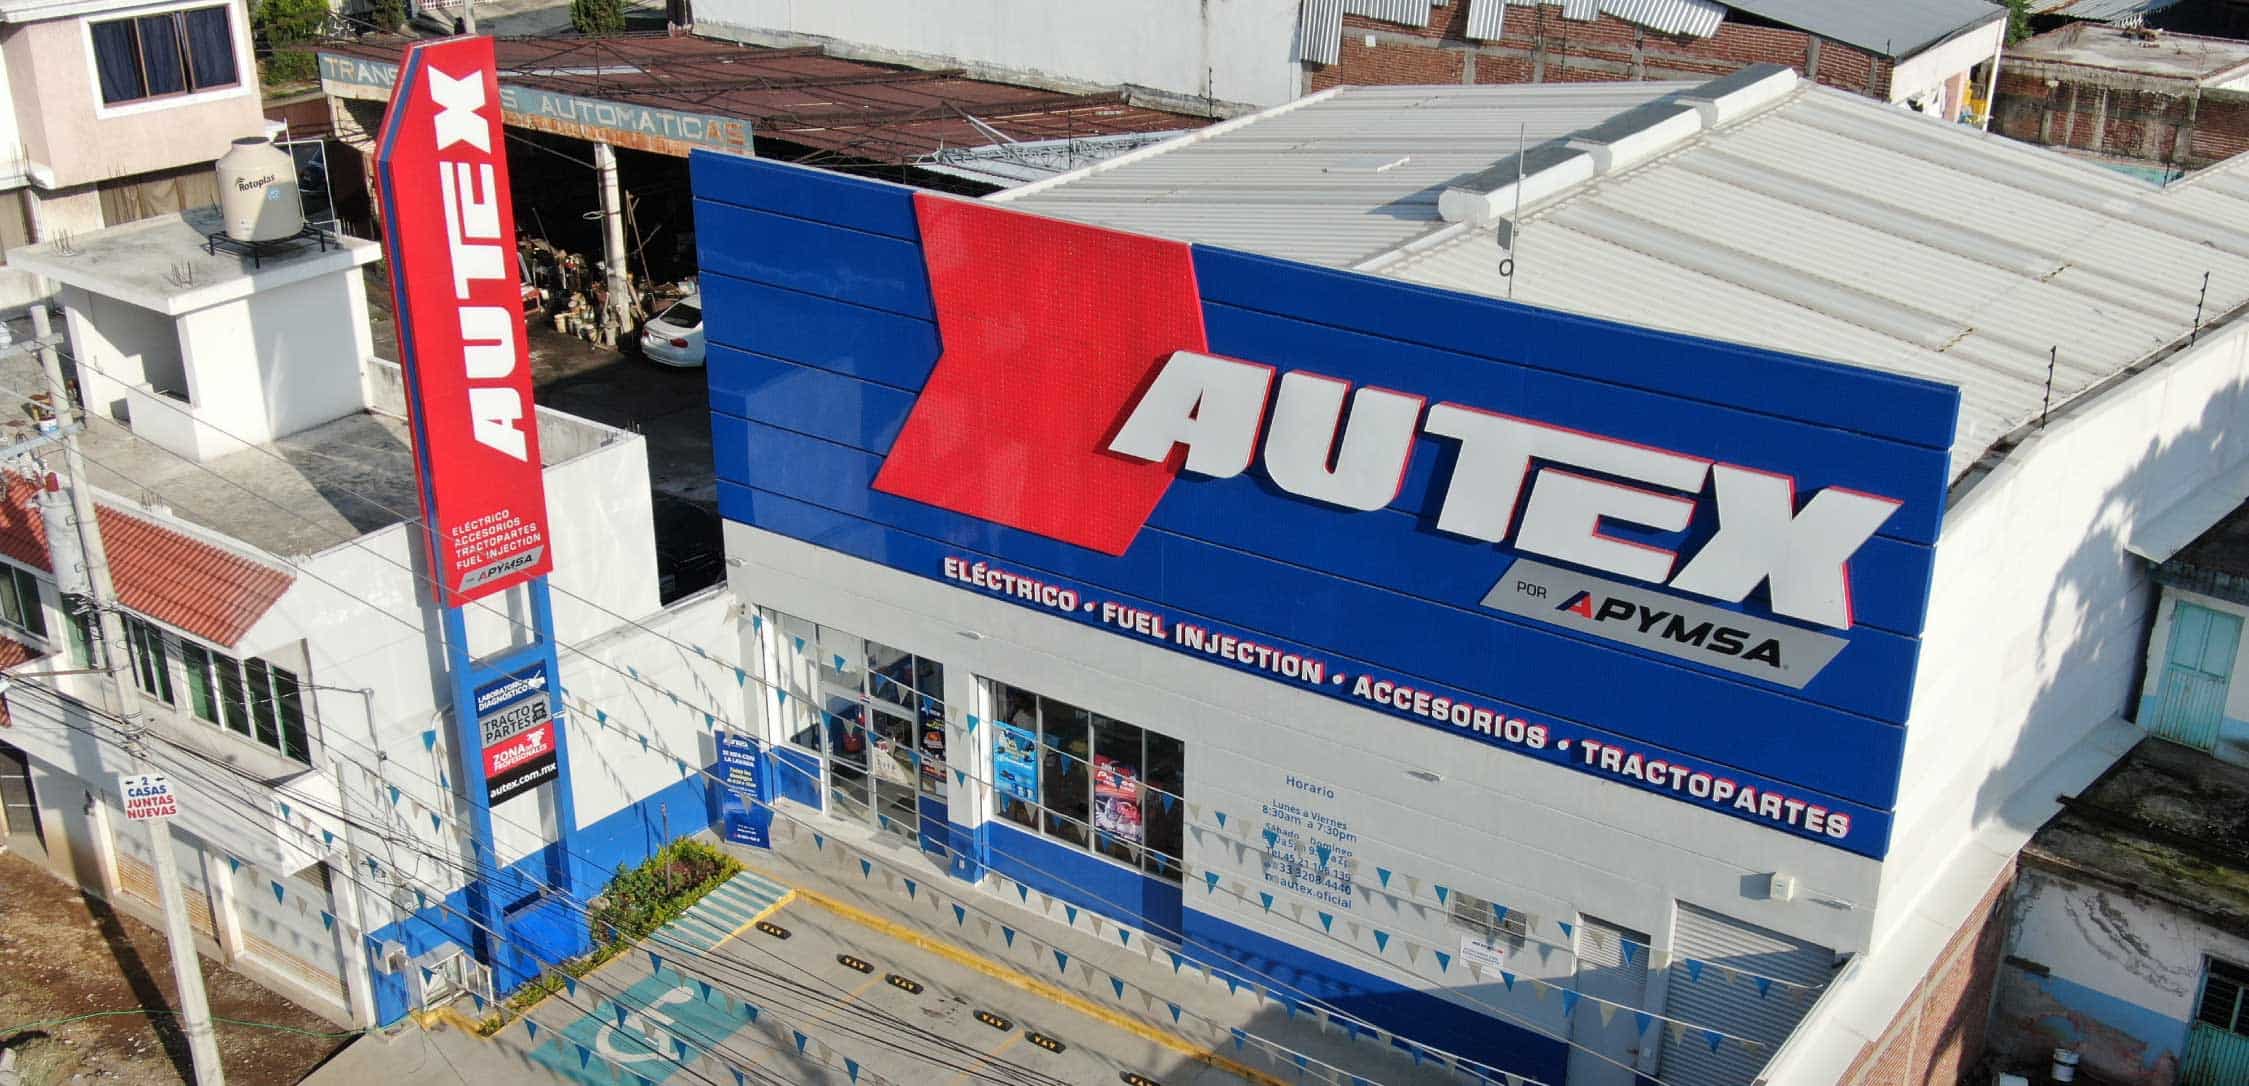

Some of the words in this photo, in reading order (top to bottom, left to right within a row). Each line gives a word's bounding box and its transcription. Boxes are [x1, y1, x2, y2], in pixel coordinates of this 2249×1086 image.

[541, 96, 746, 146] AUTOMATICAS
[427, 64, 529, 463] AUTEX
[1107, 347, 1905, 631] AUTEX
[452, 509, 510, 537] ELÉCTRICO
[454, 517, 521, 548] ACCESORIOS
[456, 522, 537, 559] TRACTOPARTES
[456, 554, 483, 571] FUEL
[486, 533, 542, 560] INJECTION
[478, 554, 534, 582] APYMSA
[1516, 580, 1548, 600] POR
[1555, 590, 1783, 669] APYMSA
[943, 556, 1079, 613] ELÉCTRICO
[1102, 602, 1167, 640] FUEL
[1176, 622, 1326, 685] INJECTION
[1353, 674, 1550, 750] ACCESORIOS
[1580, 738, 1854, 840] TRACTOPARTES
[484, 705, 530, 732] TRACTO
[486, 716, 531, 744] PARTES
[493, 743, 526, 763] ZONA
[128, 785, 167, 797] CASAS
[141, 776, 148, 785] 2
[490, 762, 557, 798] autex.com.mx
[1286, 775, 1335, 799] Horario
[127, 806, 177, 819] NUEVAS
[128, 795, 174, 808] JUNTAS
[1273, 800, 1301, 816] Lunes
[1311, 811, 1348, 830] Viernes
[1317, 822, 1357, 843] 7:30pm
